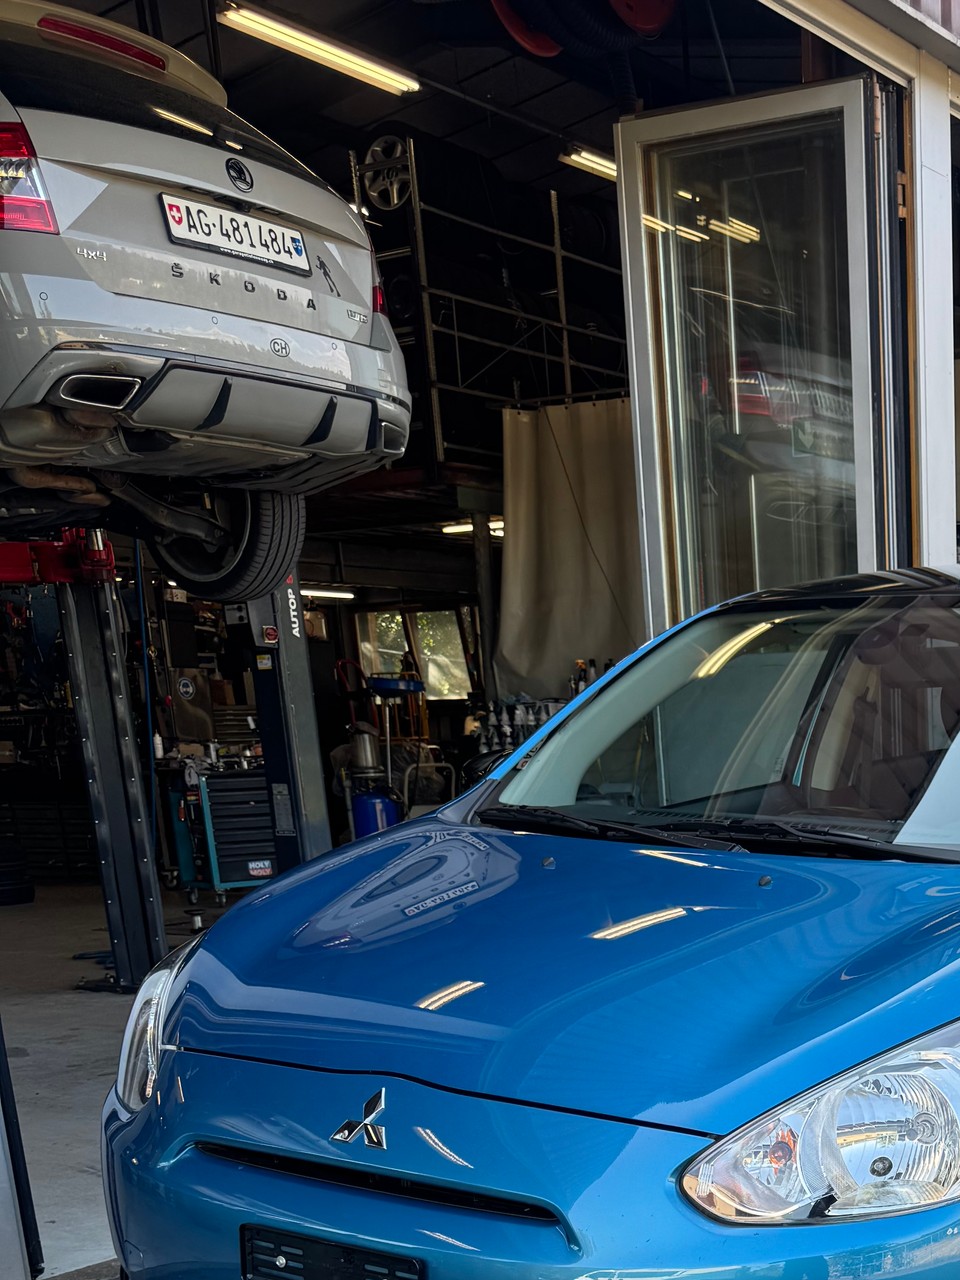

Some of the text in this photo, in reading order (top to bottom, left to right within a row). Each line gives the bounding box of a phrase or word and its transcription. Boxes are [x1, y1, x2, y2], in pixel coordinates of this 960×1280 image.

[76, 247, 107, 262] 4x4
[171, 262, 317, 311] ŠKODA
[272, 340, 289, 355] CH
[248, 860, 271, 870] HOLY
[249, 868, 273, 877] MOLY
